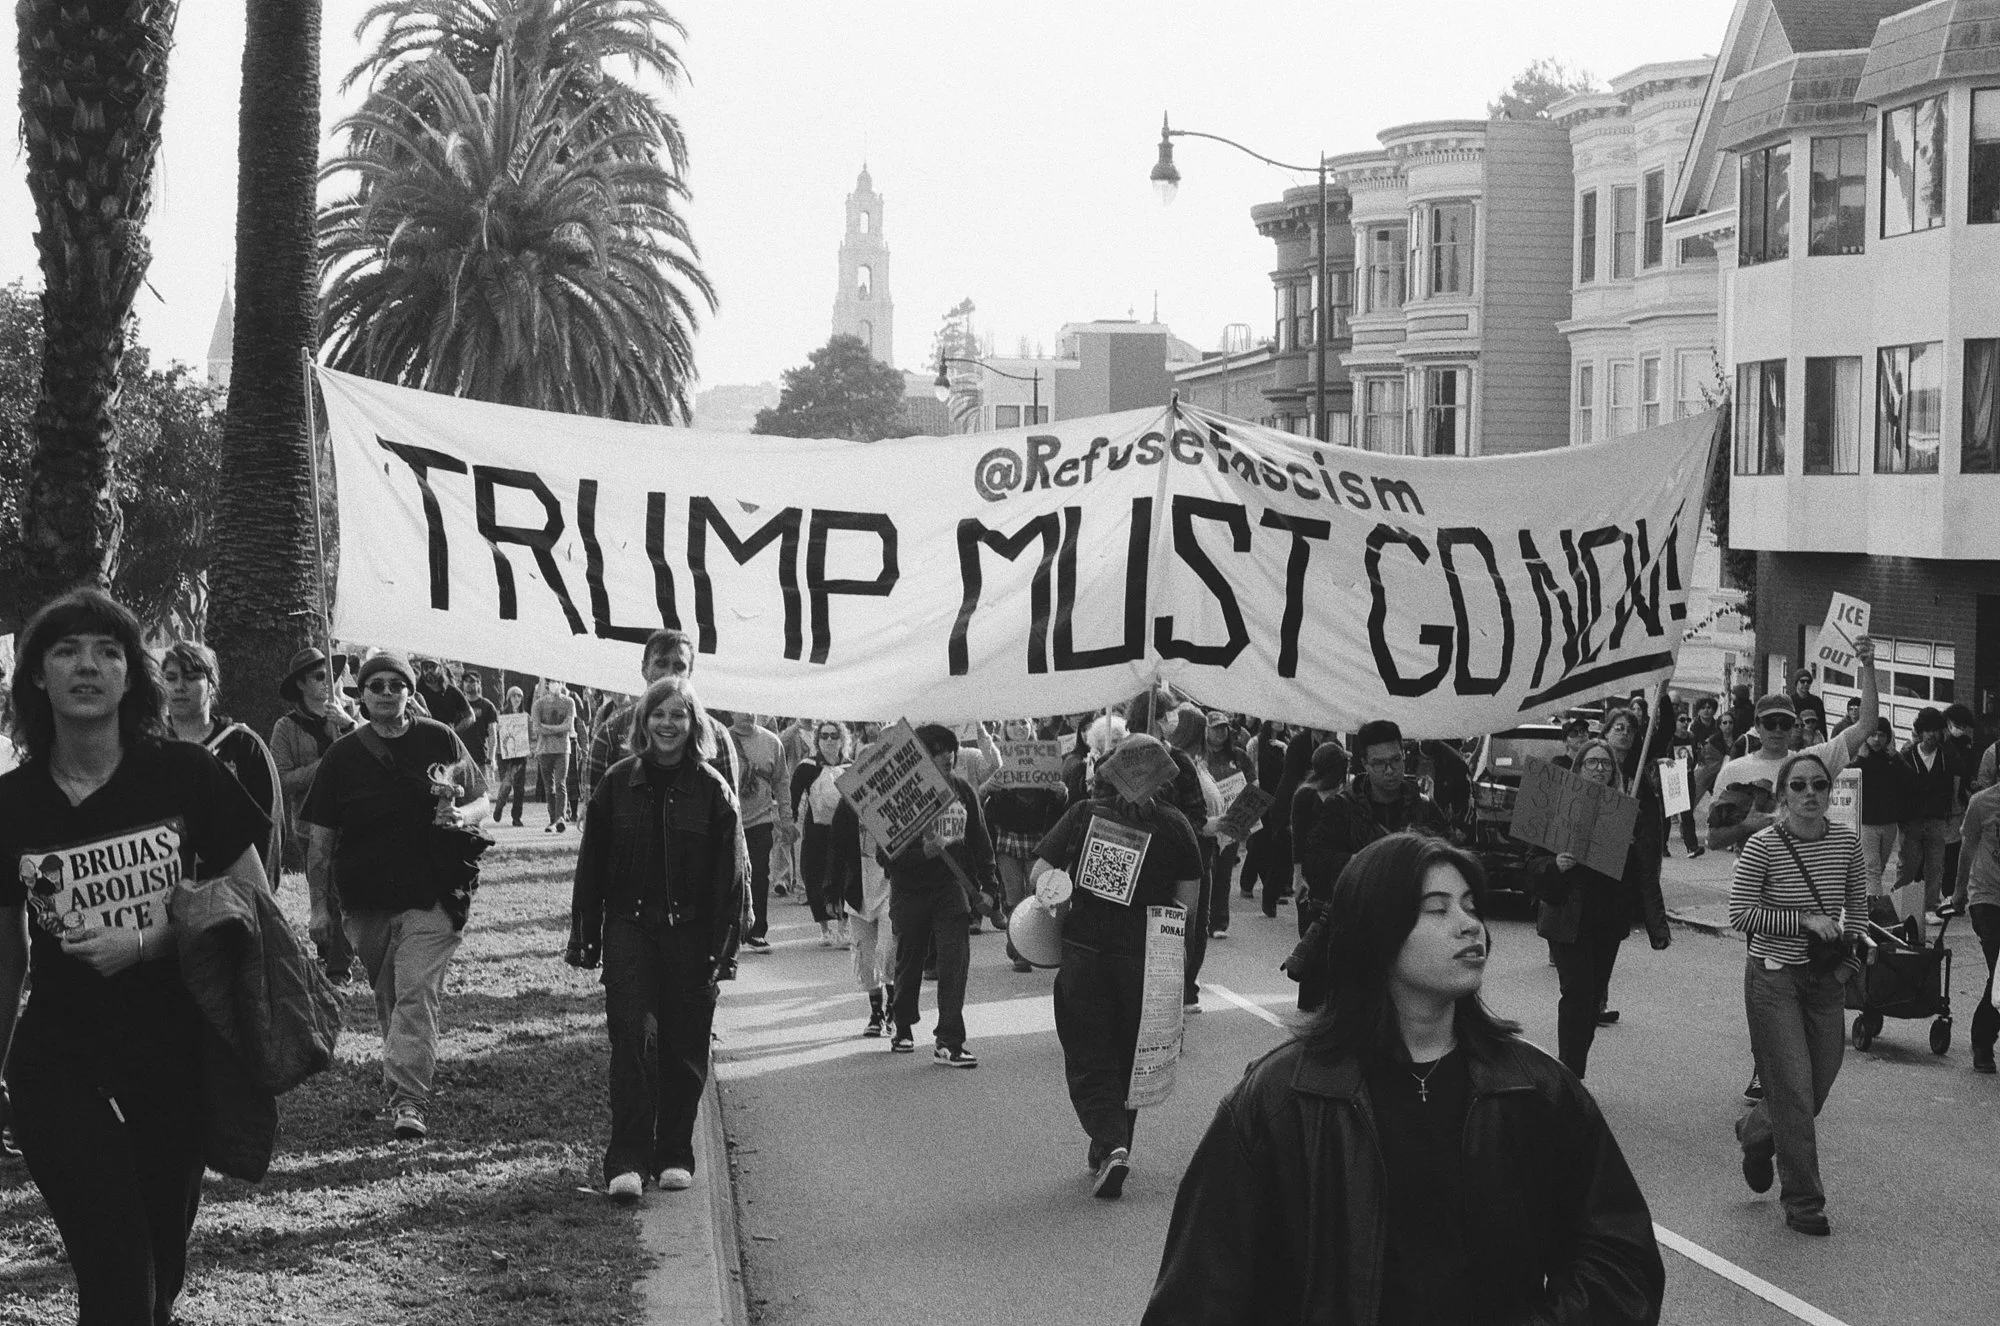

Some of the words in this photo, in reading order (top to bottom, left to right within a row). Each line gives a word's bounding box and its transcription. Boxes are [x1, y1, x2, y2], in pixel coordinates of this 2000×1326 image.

[376, 433, 900, 665] TRUMP
[948, 494, 1331, 679] MUST
[1364, 522, 1515, 697] GO
[1518, 498, 1688, 689] NOW!
[1837, 603, 1864, 627] ICE
[1819, 646, 1854, 667] OUT
[850, 785, 868, 803] WE
[865, 758, 895, 789] WON'T
[893, 738, 916, 765] WAIT
[875, 750, 923, 797] MIDTERMS
[1018, 757, 1034, 765] FOR
[1031, 769, 1061, 783] GOOD
[876, 798, 893, 819] THE
[892, 771, 923, 802] PEOPLE
[885, 821, 901, 839] ICE
[899, 803, 918, 827] OUT
[913, 786, 937, 813] NOW!
[887, 787, 923, 824] DEMAND
[1586, 783, 1629, 809] OUT
[69, 832, 173, 881] BRUJAS
[72, 859, 180, 911] ABOLISH
[101, 901, 153, 930] ICE
[1151, 908, 1163, 918] THE
